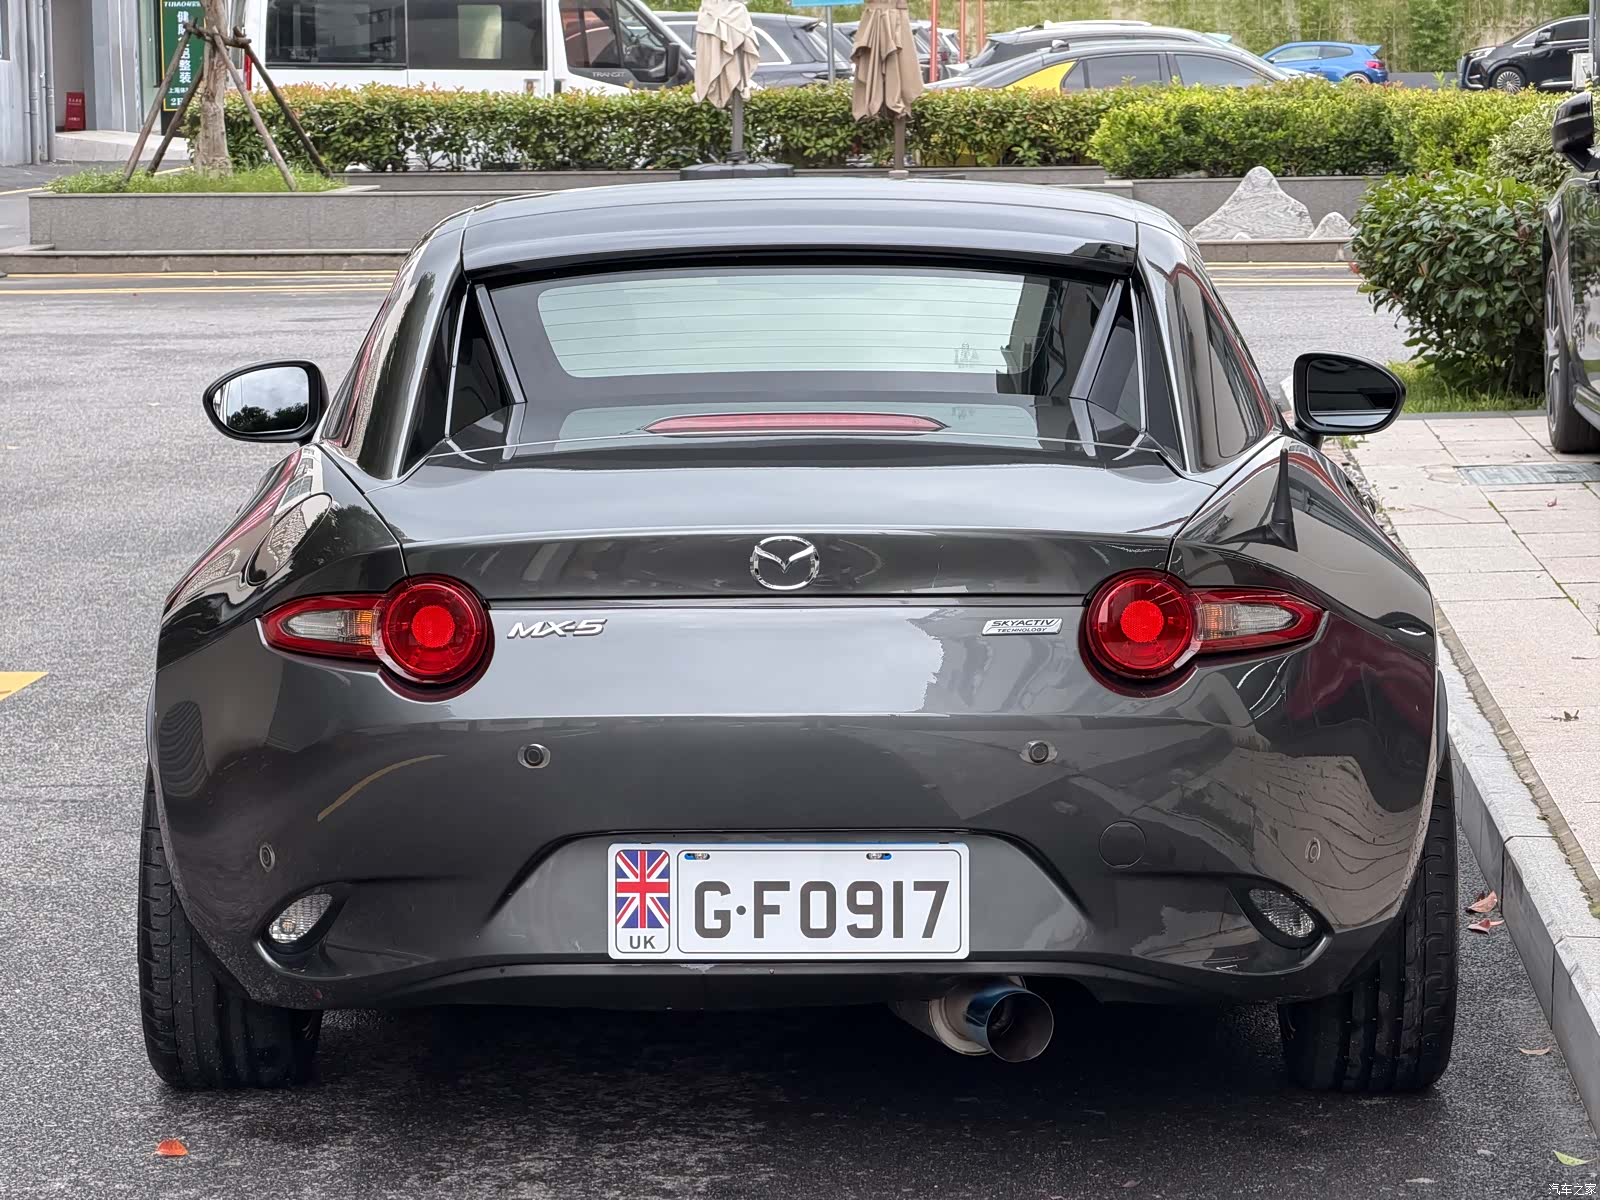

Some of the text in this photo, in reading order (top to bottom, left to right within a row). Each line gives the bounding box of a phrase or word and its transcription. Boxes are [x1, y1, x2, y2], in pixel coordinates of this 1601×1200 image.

[507, 619, 608, 639] MX-5
[991, 619, 1055, 627] SKYACTIV
[629, 935, 657, 950] UK
